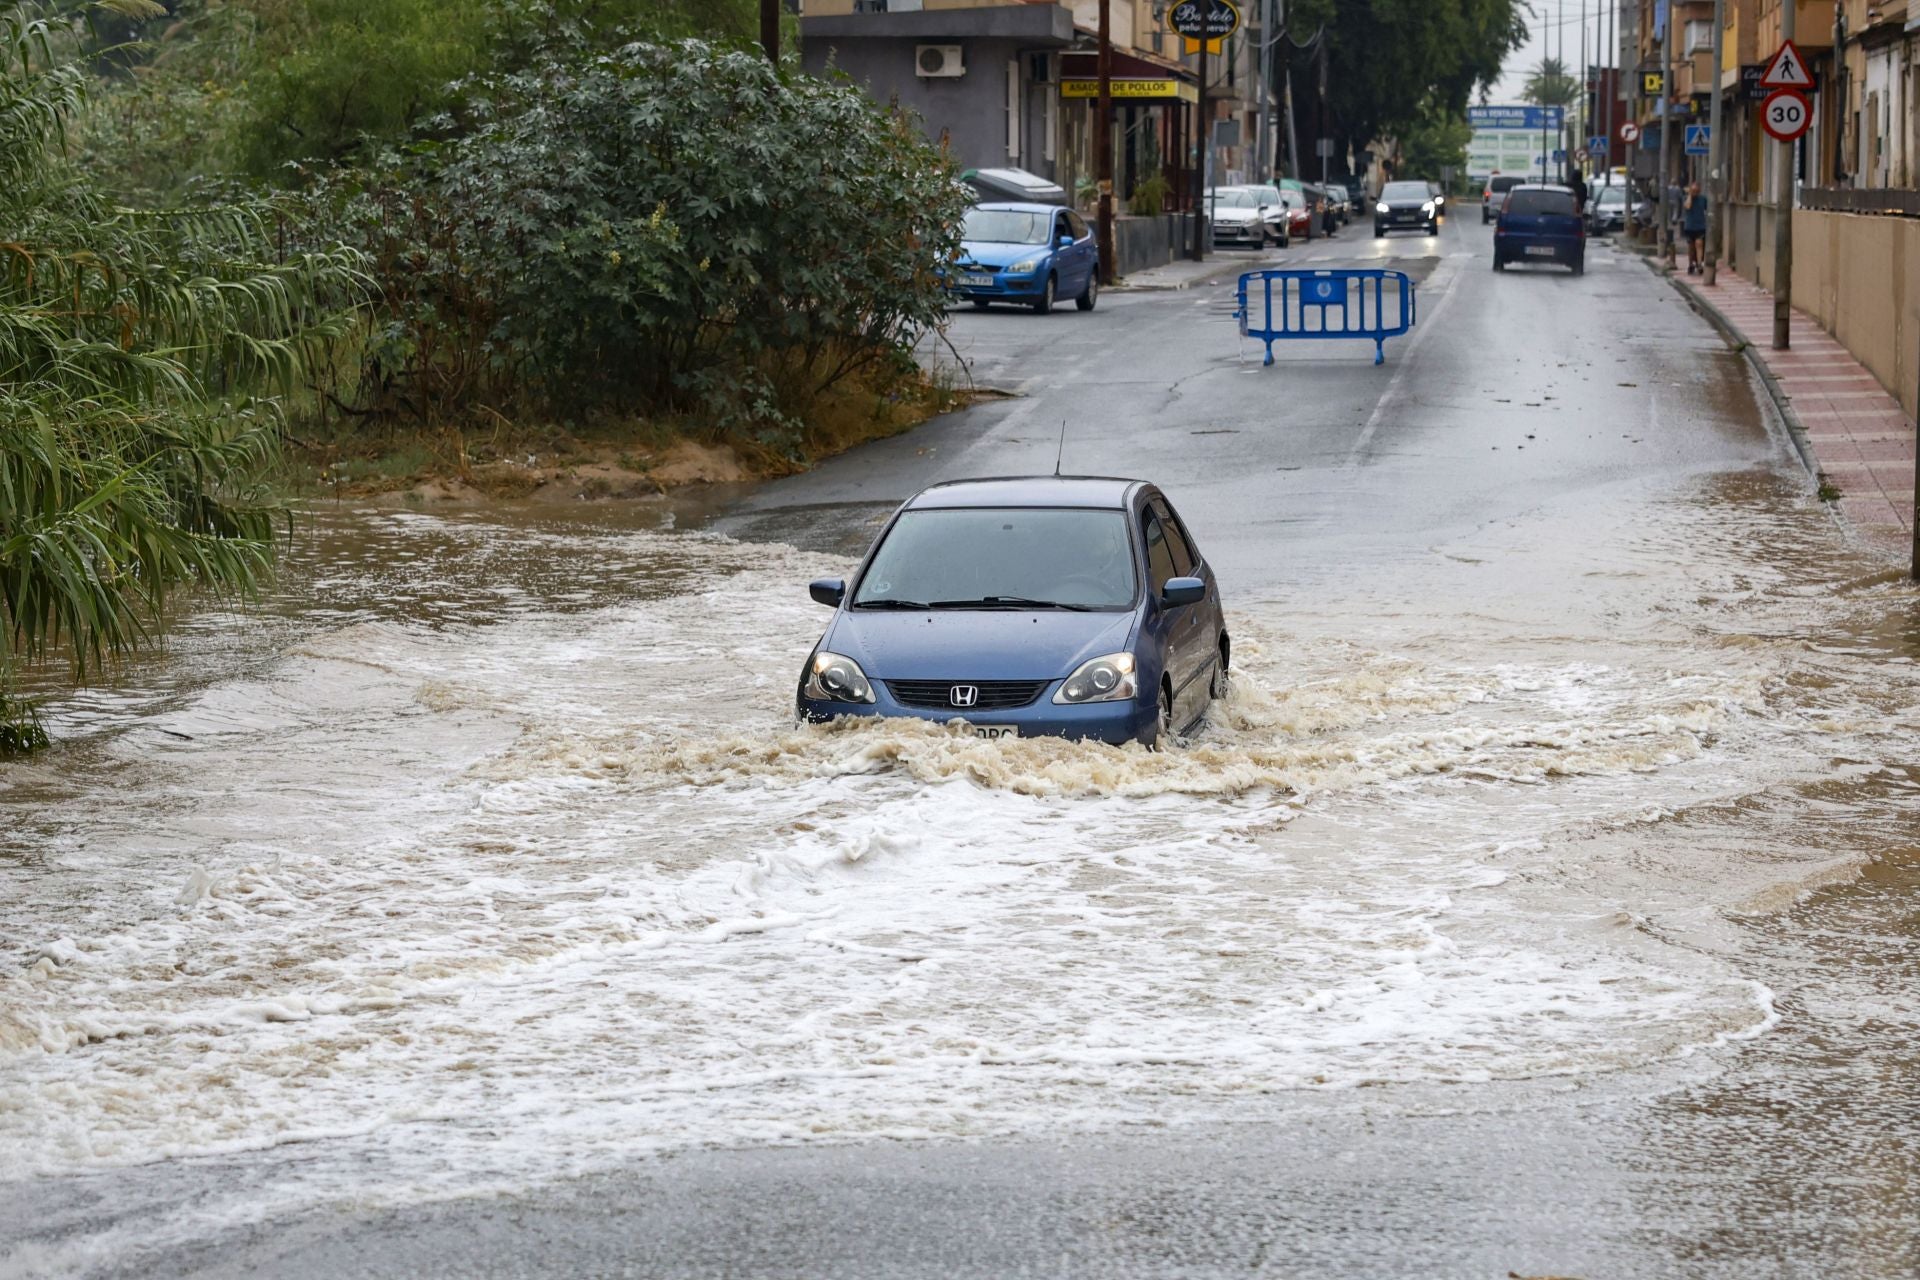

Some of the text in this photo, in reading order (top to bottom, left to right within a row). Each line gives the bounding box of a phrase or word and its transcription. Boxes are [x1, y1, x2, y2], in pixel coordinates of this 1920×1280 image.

[1175, 4, 1233, 22] Batolo
[1069, 83, 1167, 92] ASADO DE POLLOS
[1772, 106, 1800, 123] 30
